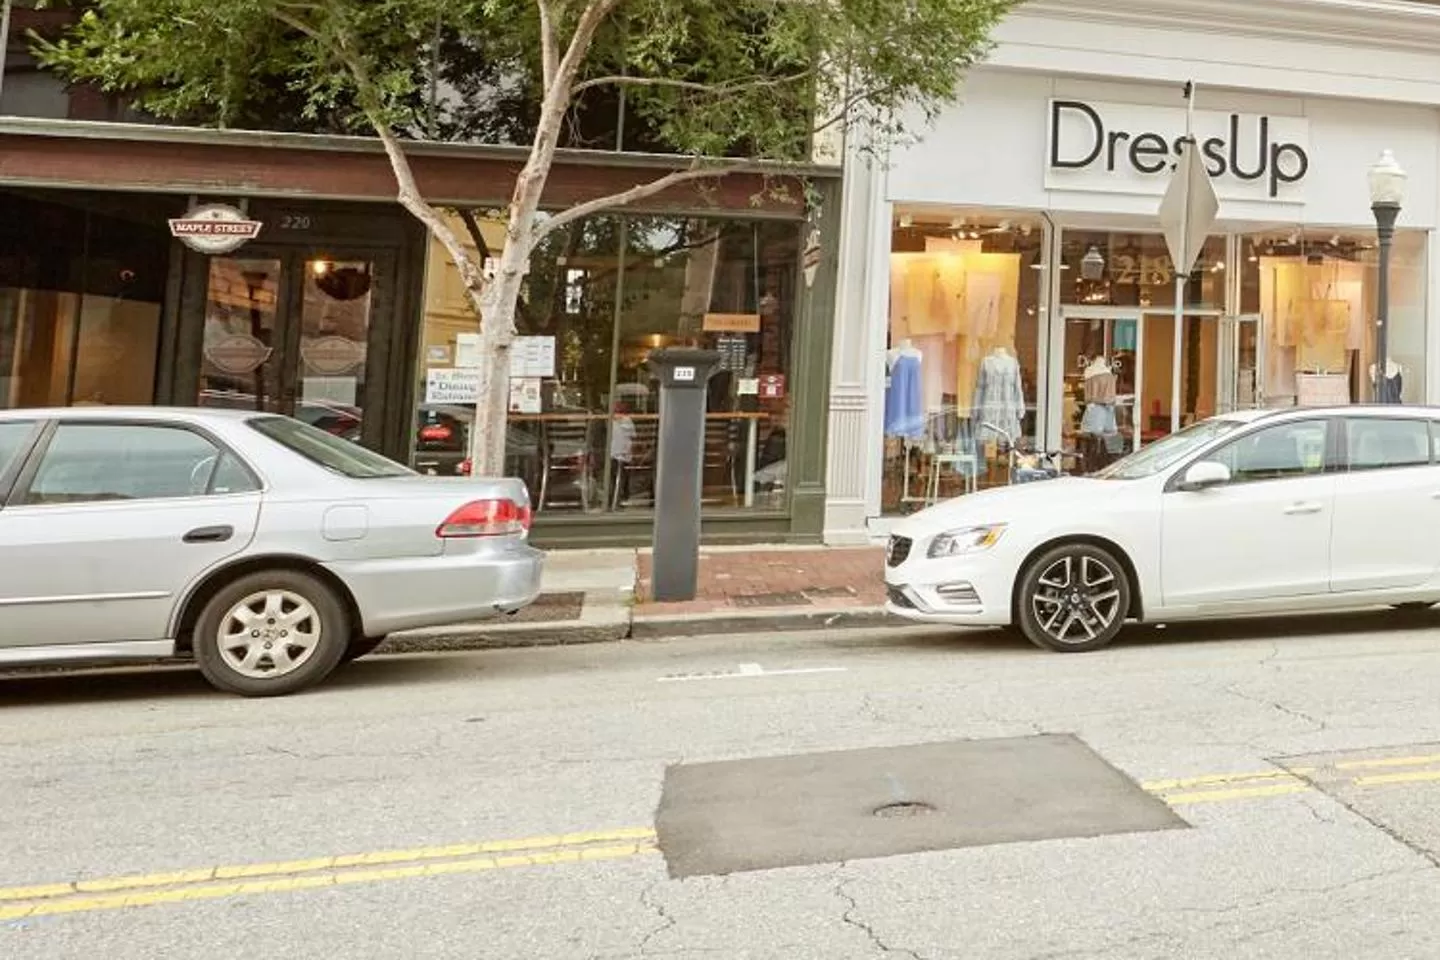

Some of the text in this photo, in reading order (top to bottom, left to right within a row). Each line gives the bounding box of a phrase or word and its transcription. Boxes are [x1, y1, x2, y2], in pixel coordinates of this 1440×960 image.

[1051, 100, 1309, 197] DressUp
[175, 223, 254, 234] MAPLE STREET
[280, 215, 311, 230] 220
